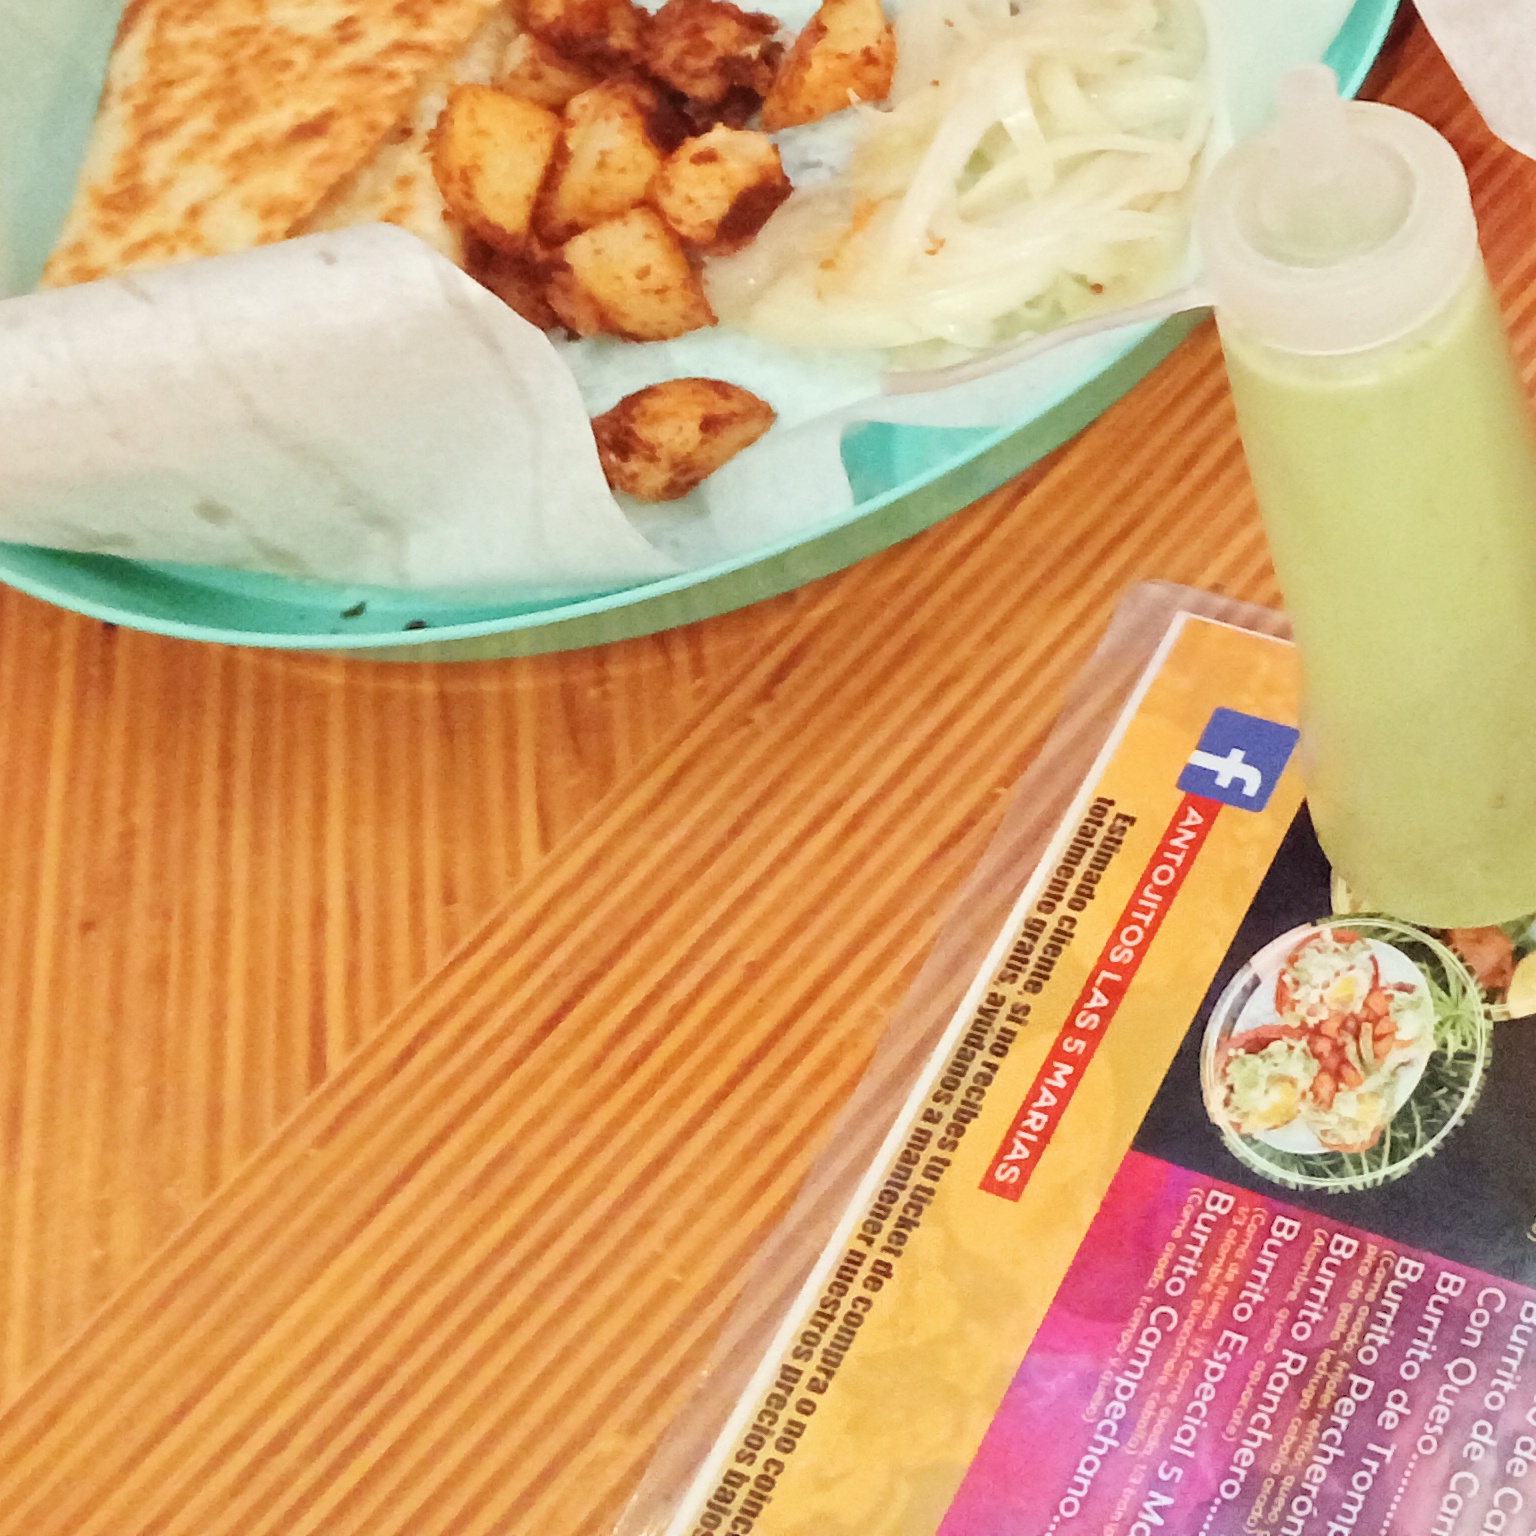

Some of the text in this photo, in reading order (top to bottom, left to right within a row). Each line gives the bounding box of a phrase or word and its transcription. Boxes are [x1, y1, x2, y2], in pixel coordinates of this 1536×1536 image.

[1036, 796, 1115, 914] totalmente
[1066, 812, 1136, 912] Estimado
[993, 917, 1047, 985] gratis,
[993, 805, 1204, 1184] ANTOJITOS LAS 5 MARIAS
[1017, 914, 1077, 995] cliente,
[931, 991, 1006, 1105] ayúdanos
[988, 1026, 1017, 1058] no
[1004, 1002, 1031, 1025] si
[921, 1107, 943, 1125] a
[936, 1059, 999, 1152] recibes
[856, 1126, 933, 1247] mantener
[920, 1155, 951, 1182] tu
[880, 1183, 936, 1257] ticket
[1232, 1215, 1301, 1322] Burrito
[791, 1248, 867, 1362] nuestros
[862, 1258, 893, 1292] de
[805, 1295, 873, 1394] compra
[1058, 1189, 1236, 1518] Burrito Campechano
[1219, 1232, 1359, 1500] Burrito Ranchero
[1398, 1270, 1466, 1381] Burrito
[1416, 1286, 1507, 1462] Con Queso
[734, 1363, 803, 1466] precios
[774, 1418, 806, 1454] no
[794, 1397, 817, 1417] o
[1168, 1329, 1248, 1458] Especial
[1279, 1255, 1425, 1535] Burrito Percherón
[1376, 1388, 1411, 1430] de
[1461, 1418, 1498, 1468] de
[1157, 1459, 1184, 1483] 5
